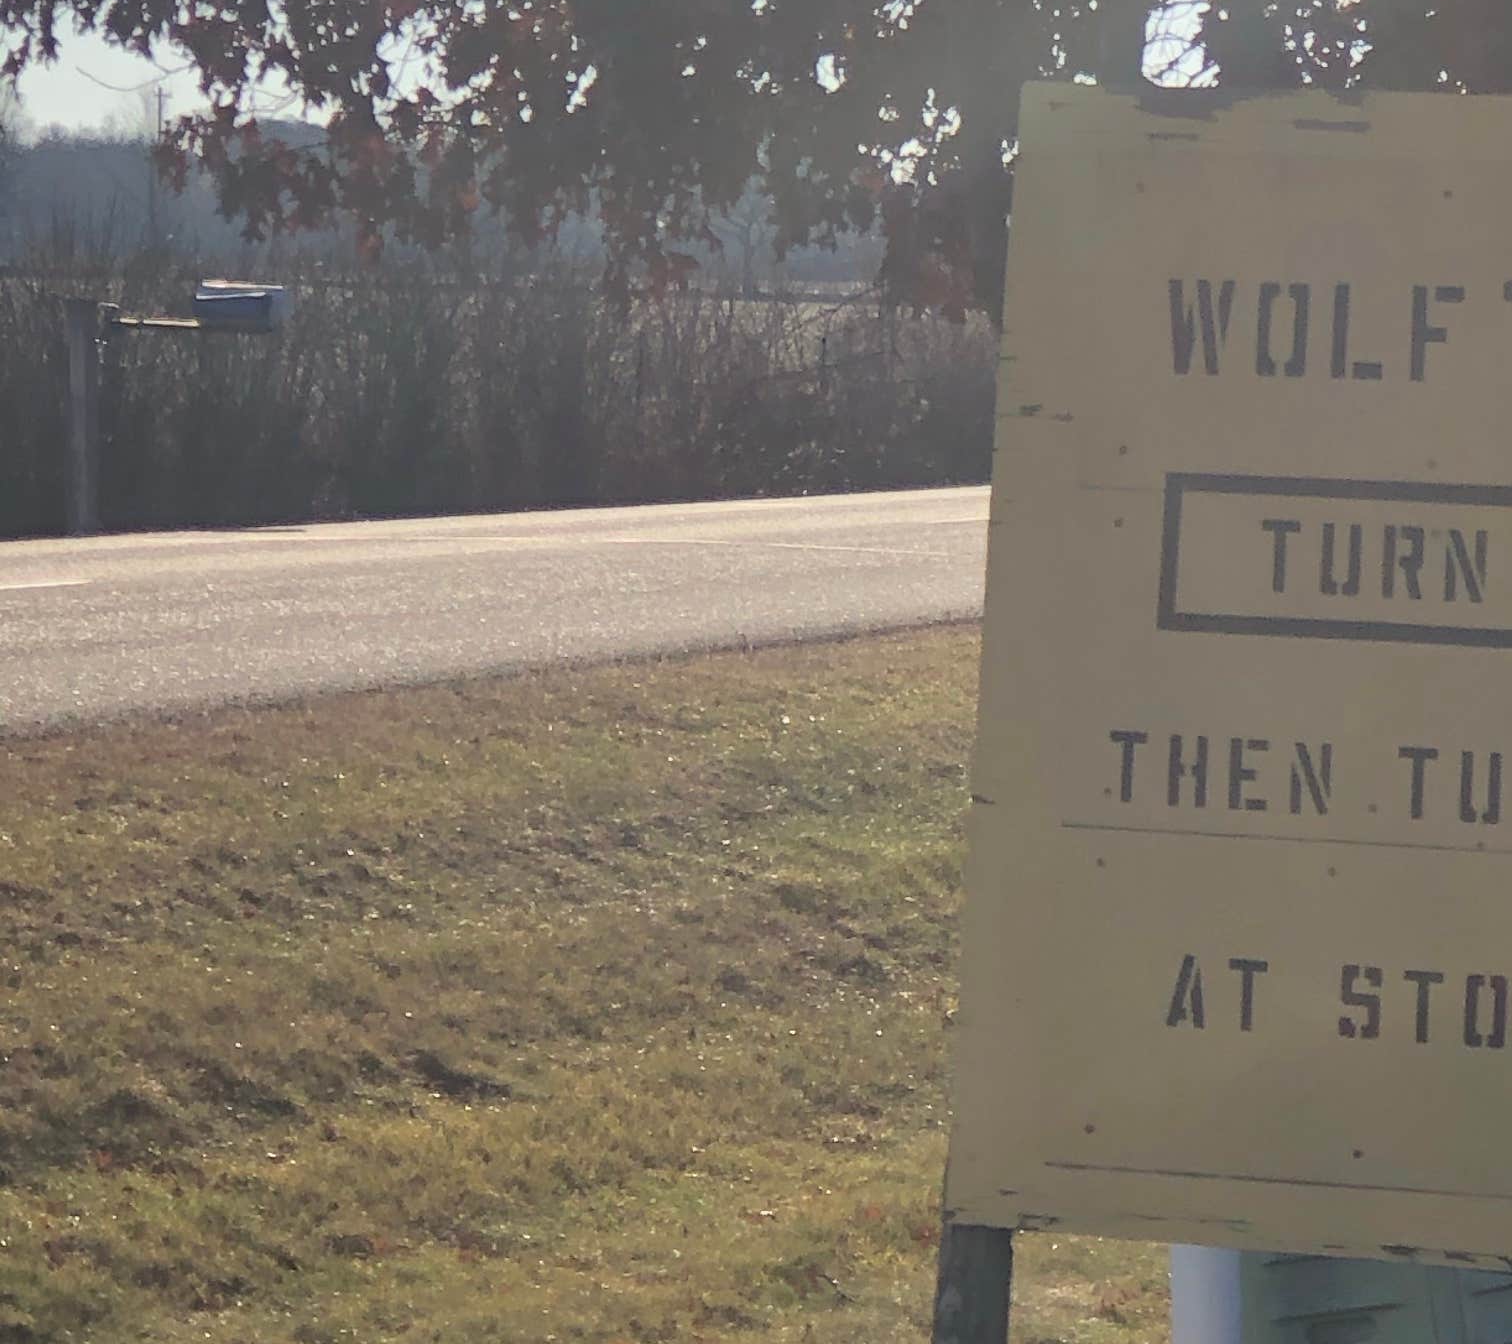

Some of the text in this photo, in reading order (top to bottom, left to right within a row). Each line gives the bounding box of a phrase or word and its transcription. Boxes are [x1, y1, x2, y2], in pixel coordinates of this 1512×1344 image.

[1260, 518, 1490, 605] TURN
[1110, 730, 1333, 815] THEN
[1166, 953, 1269, 1032] AT
